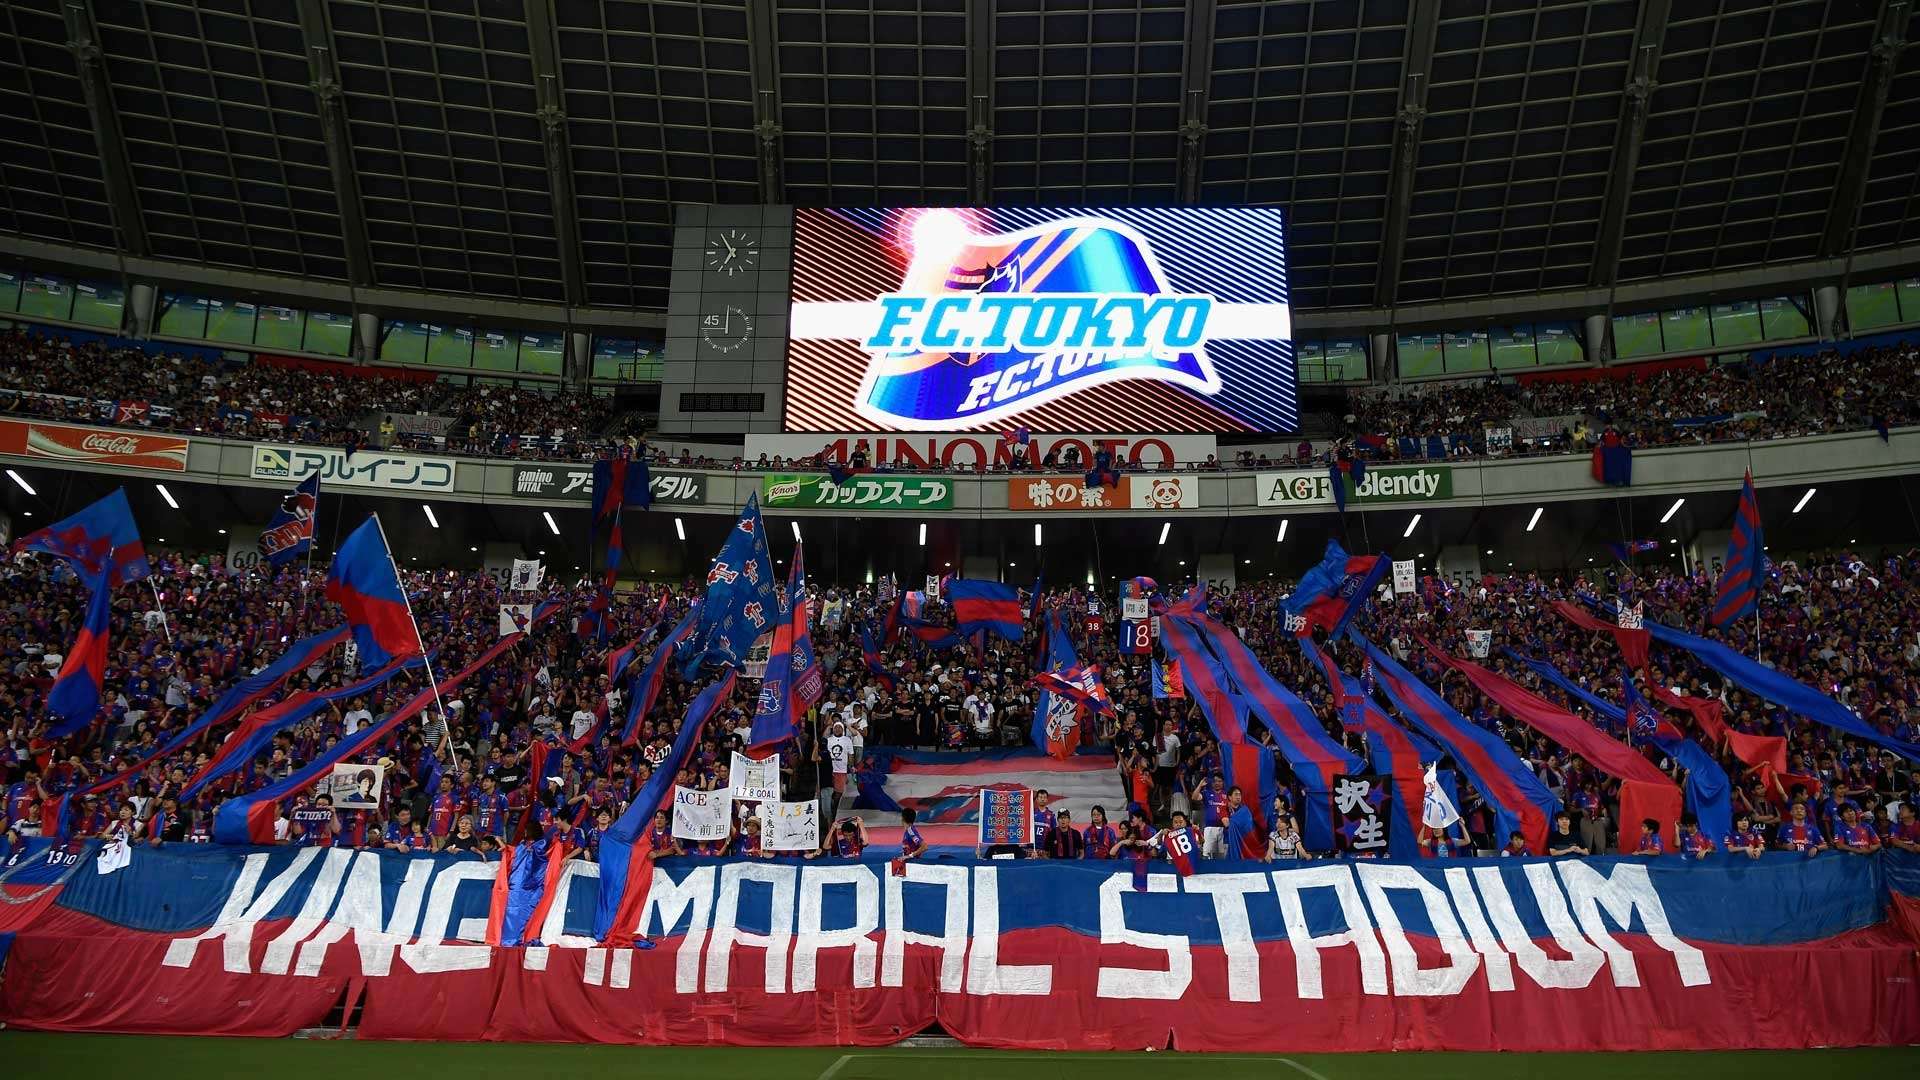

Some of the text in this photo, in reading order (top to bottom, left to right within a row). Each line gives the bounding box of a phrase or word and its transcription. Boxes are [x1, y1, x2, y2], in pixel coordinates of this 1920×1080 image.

[704, 315, 720, 326] 45
[866, 297, 1213, 347] F.C.TOKYO
[82, 433, 139, 454] Coca-Cola
[256, 468, 288, 476] ALINCO
[294, 452, 451, 486] アルインコ
[518, 469, 553, 483] amino
[517, 483, 542, 493] VITAL
[771, 484, 799, 497] Knorr
[1268, 475, 1332, 501] AGF
[1355, 469, 1440, 497] Blendy
[816, 481, 947, 505] カップスープ
[232, 551, 258, 570] 60
[1087, 622, 1100, 631] 38
[1126, 624, 1150, 648] 18
[676, 791, 708, 807] ACE
[735, 787, 776, 799] 178 GOAL
[700, 824, 726, 837] 前田
[1036, 827, 1044, 836] 12
[1171, 834, 1193, 857] 18
[8, 853, 19, 866] 6
[47, 850, 64, 864] 13
[1097, 859, 1711, 1002] STADIUM
